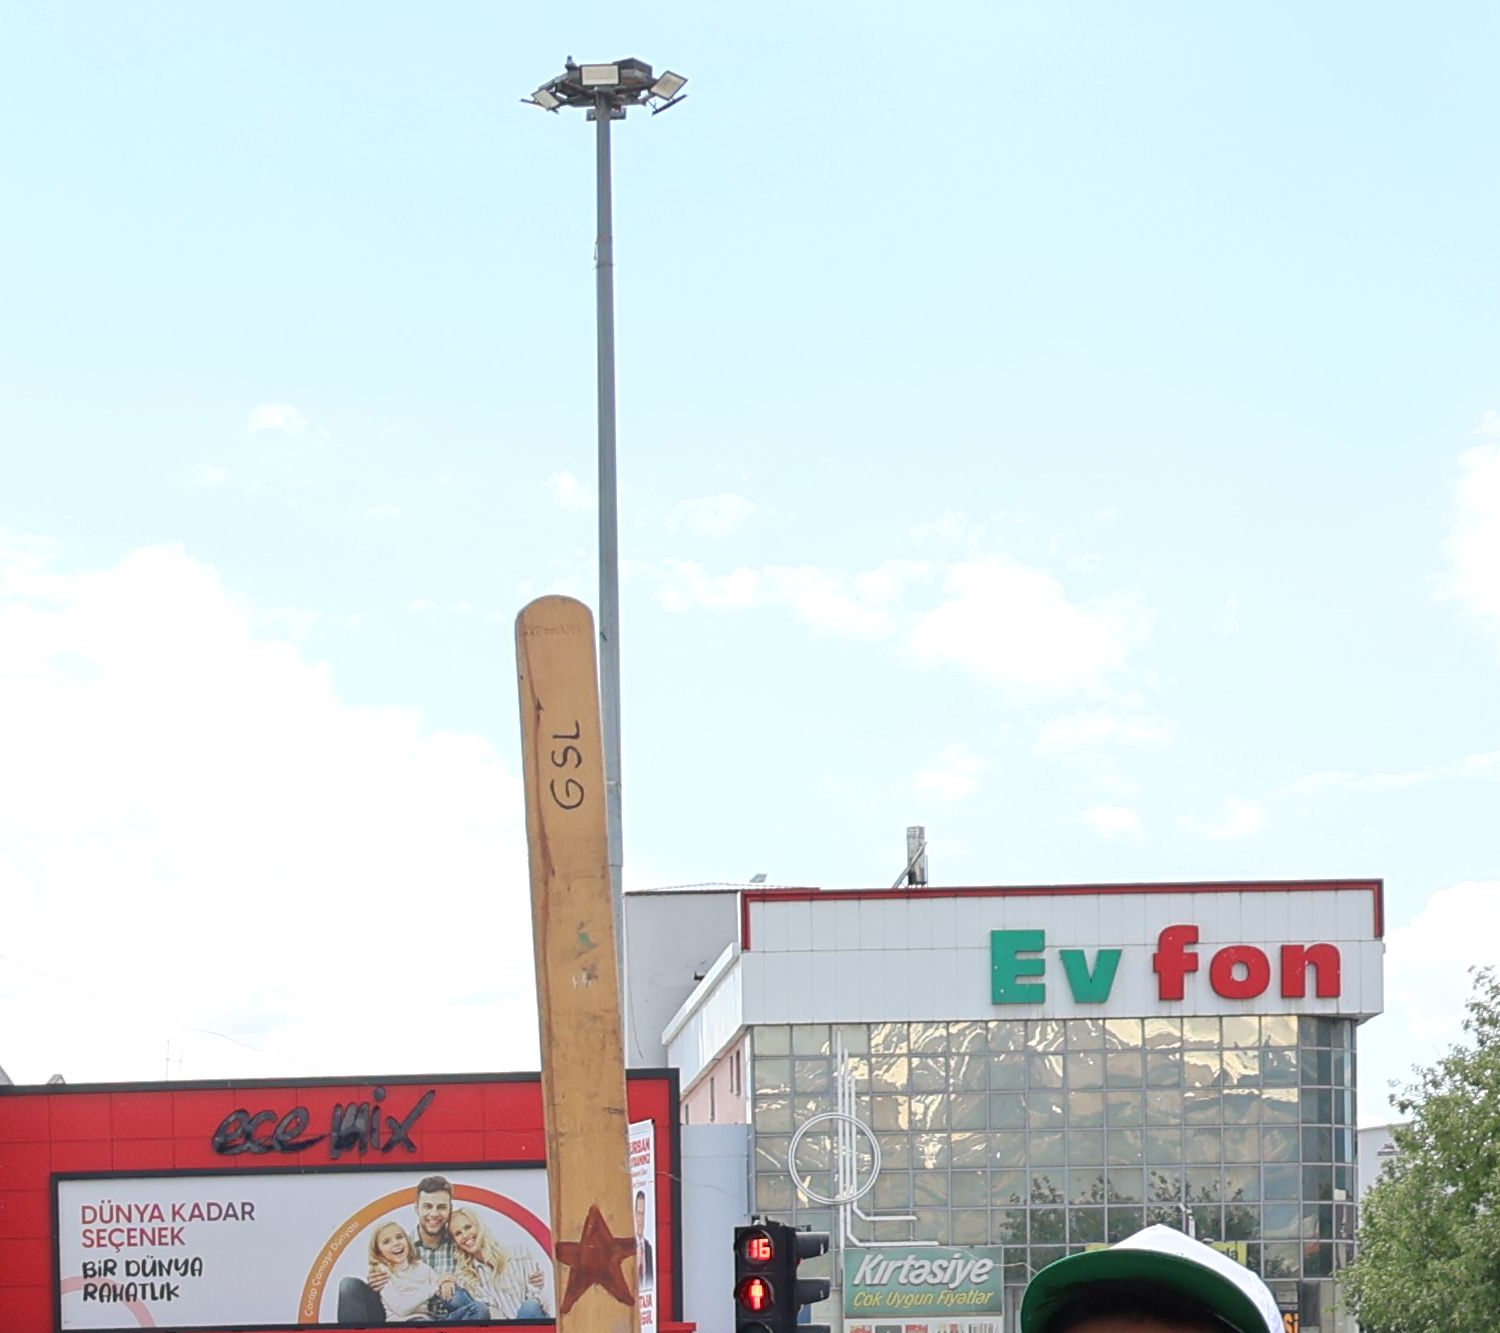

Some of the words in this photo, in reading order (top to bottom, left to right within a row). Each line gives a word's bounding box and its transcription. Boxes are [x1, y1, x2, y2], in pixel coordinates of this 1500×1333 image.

[550, 720, 585, 810] GSL
[991, 930, 1122, 1004] Ev
[1153, 924, 1341, 1000] fon
[81, 1200, 165, 1225] DÜNYA
[171, 1201, 255, 1223] KADAR
[82, 1227, 186, 1253] SEÇENEK
[749, 1239, 771, 1260] 16
[125, 1255, 204, 1278] DÜNYA
[853, 1253, 993, 1289] Kırtasiye
[83, 1282, 180, 1303] RAHATLIK
[886, 1291, 933, 1308] Uygun
[937, 1290, 994, 1306] Fiyatlar
